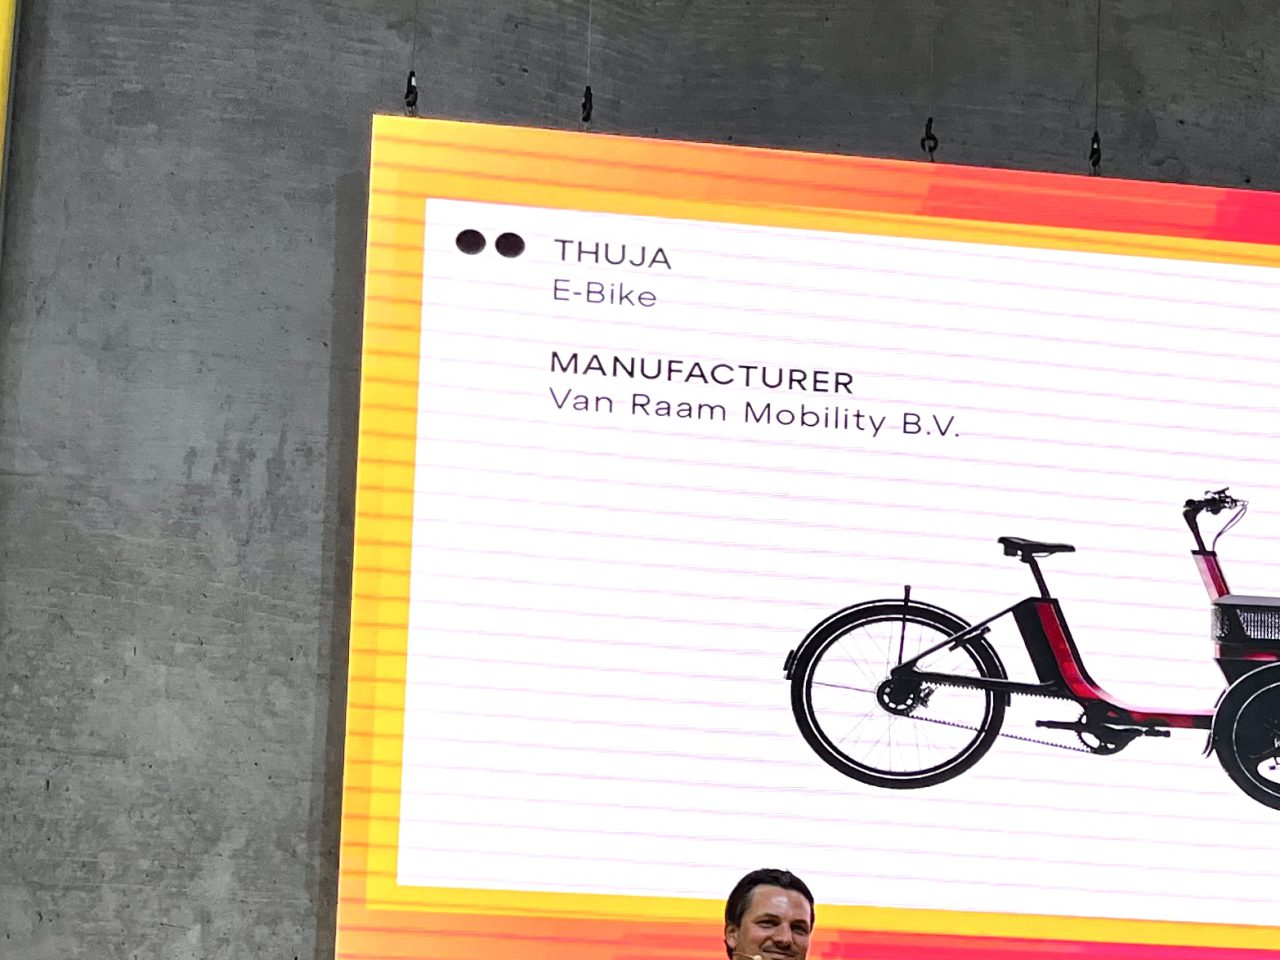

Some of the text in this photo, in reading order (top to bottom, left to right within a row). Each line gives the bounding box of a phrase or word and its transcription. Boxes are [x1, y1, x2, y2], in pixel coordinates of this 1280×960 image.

[554, 238, 672, 270] THUJA
[553, 278, 657, 308] E-Bike
[549, 351, 854, 395] MANUFACTURER
[549, 387, 960, 438] Van Raam Mobility B.V.
